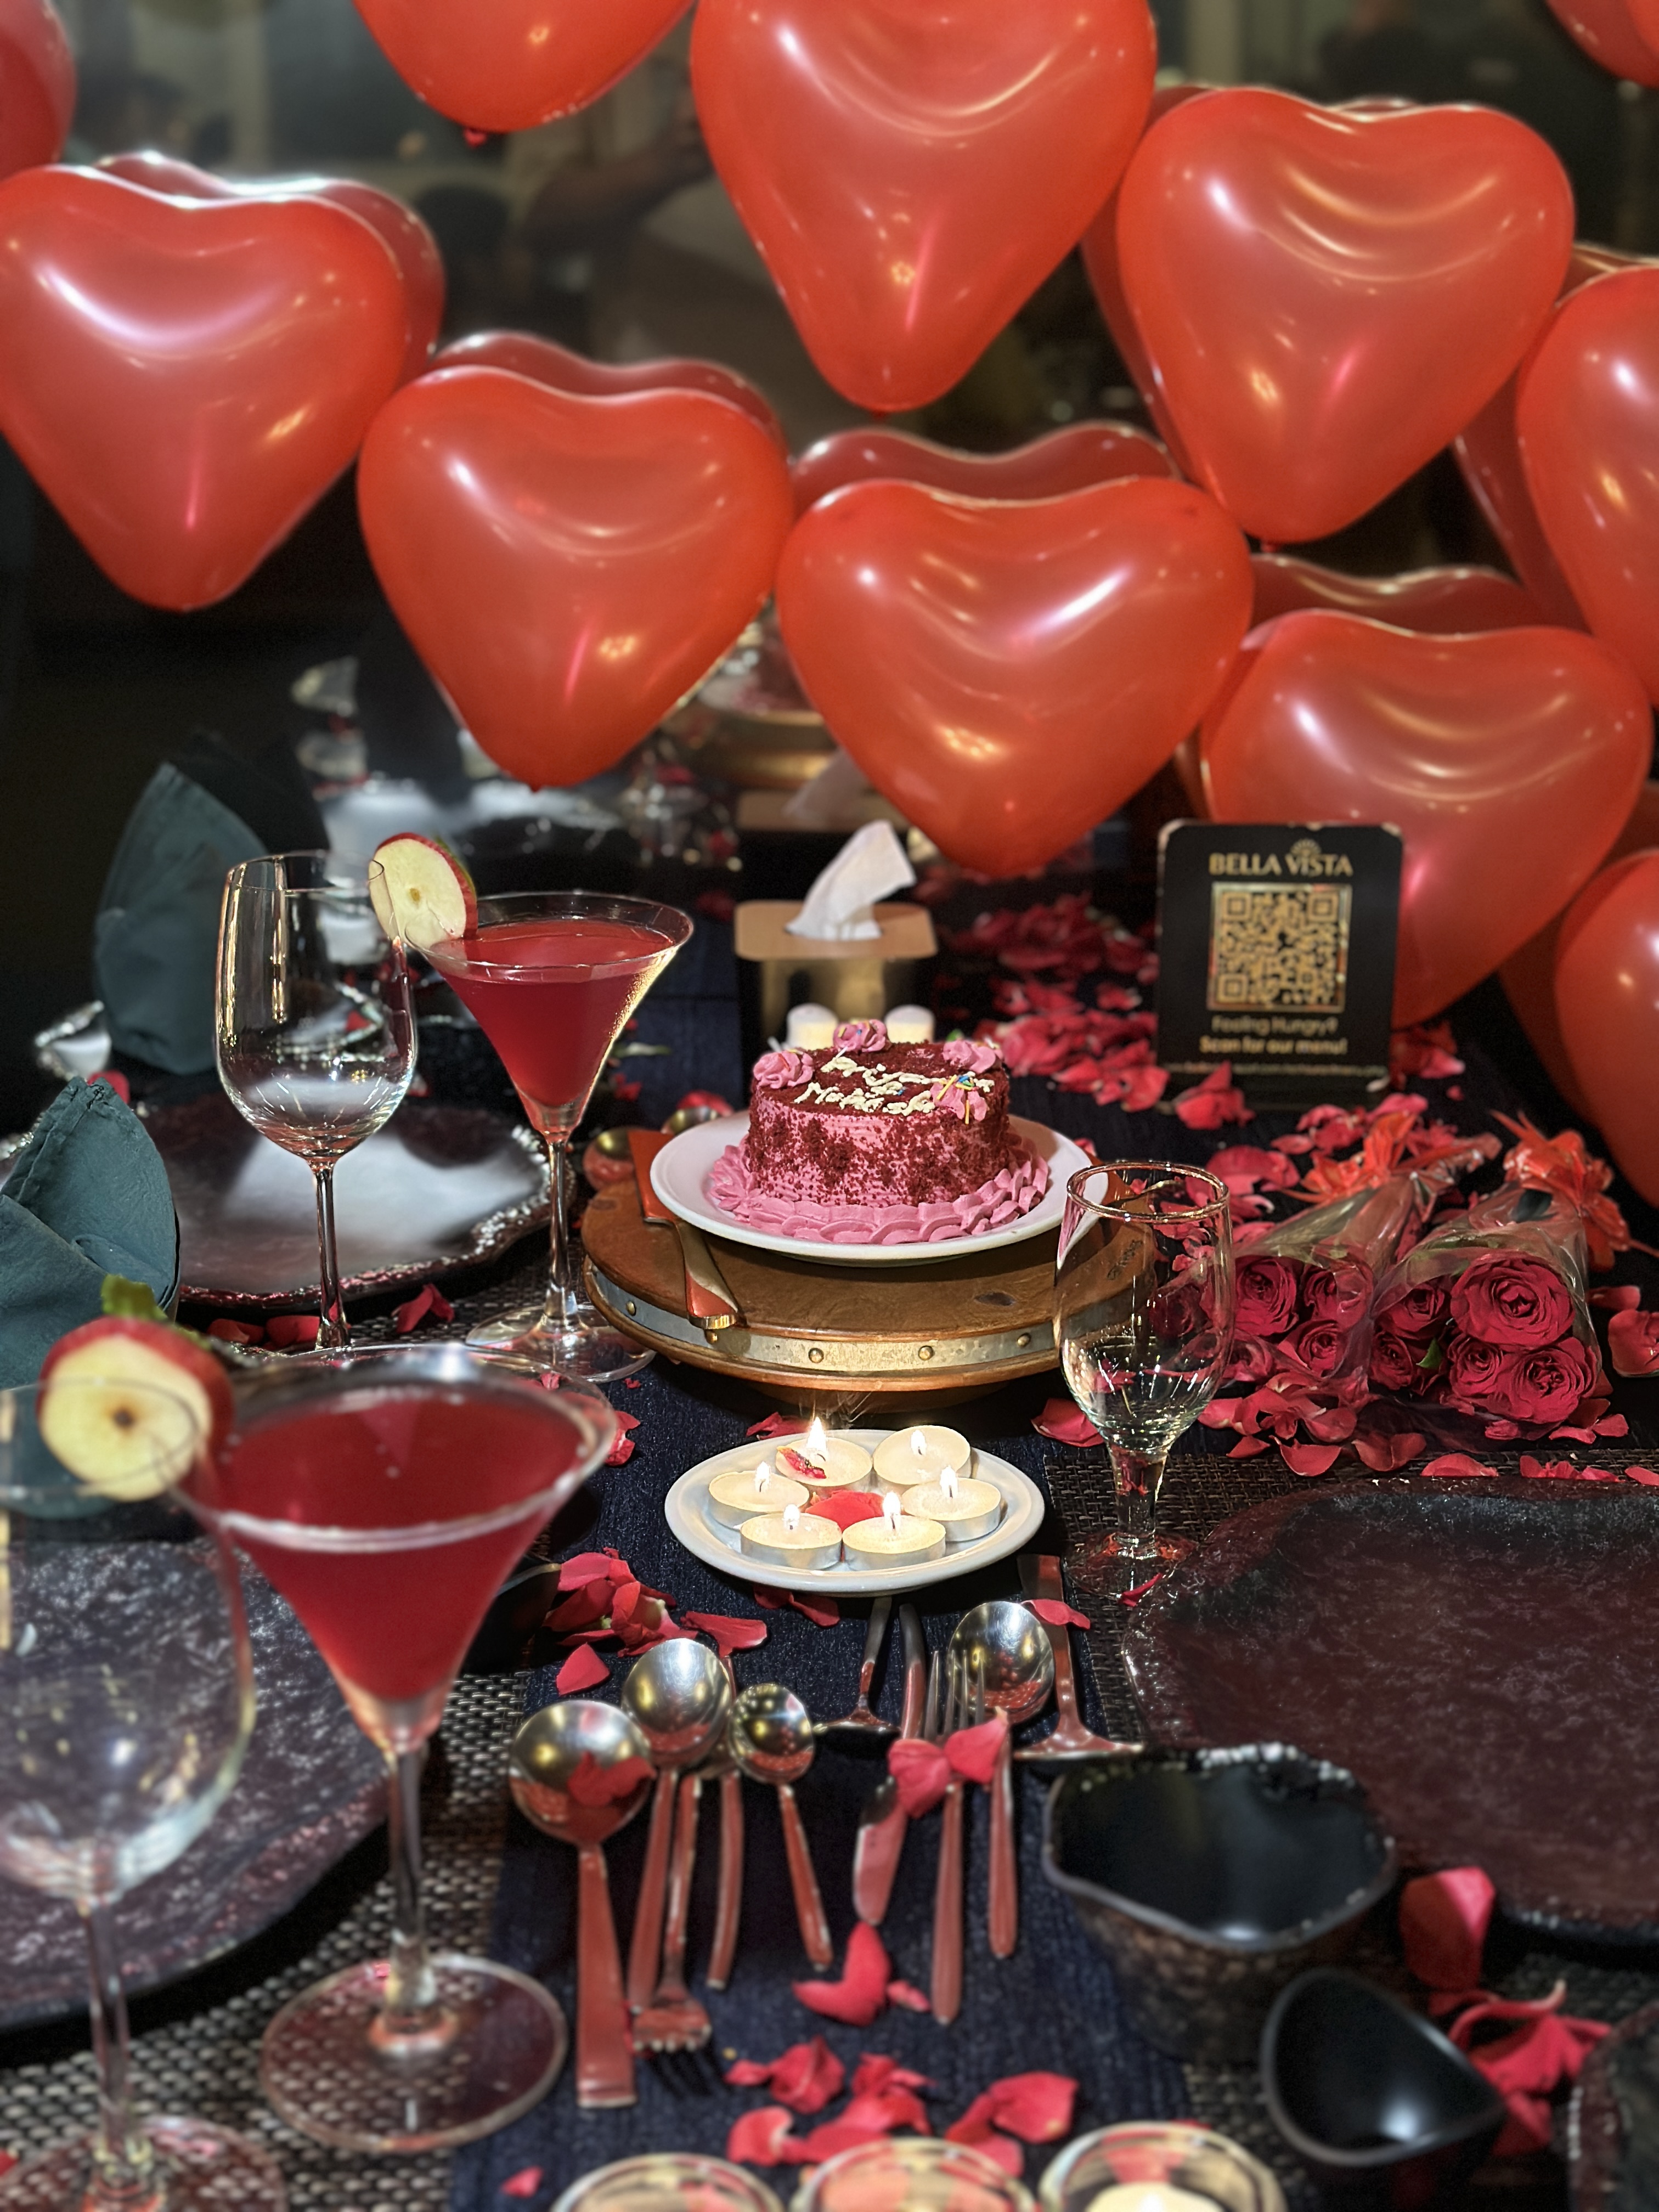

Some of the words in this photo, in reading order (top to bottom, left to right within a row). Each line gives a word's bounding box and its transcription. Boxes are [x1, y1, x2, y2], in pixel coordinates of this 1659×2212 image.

[1209, 853, 1282, 876] BELLA
[1285, 853, 1353, 876] VISTA
[1266, 1040, 1294, 1053] our
